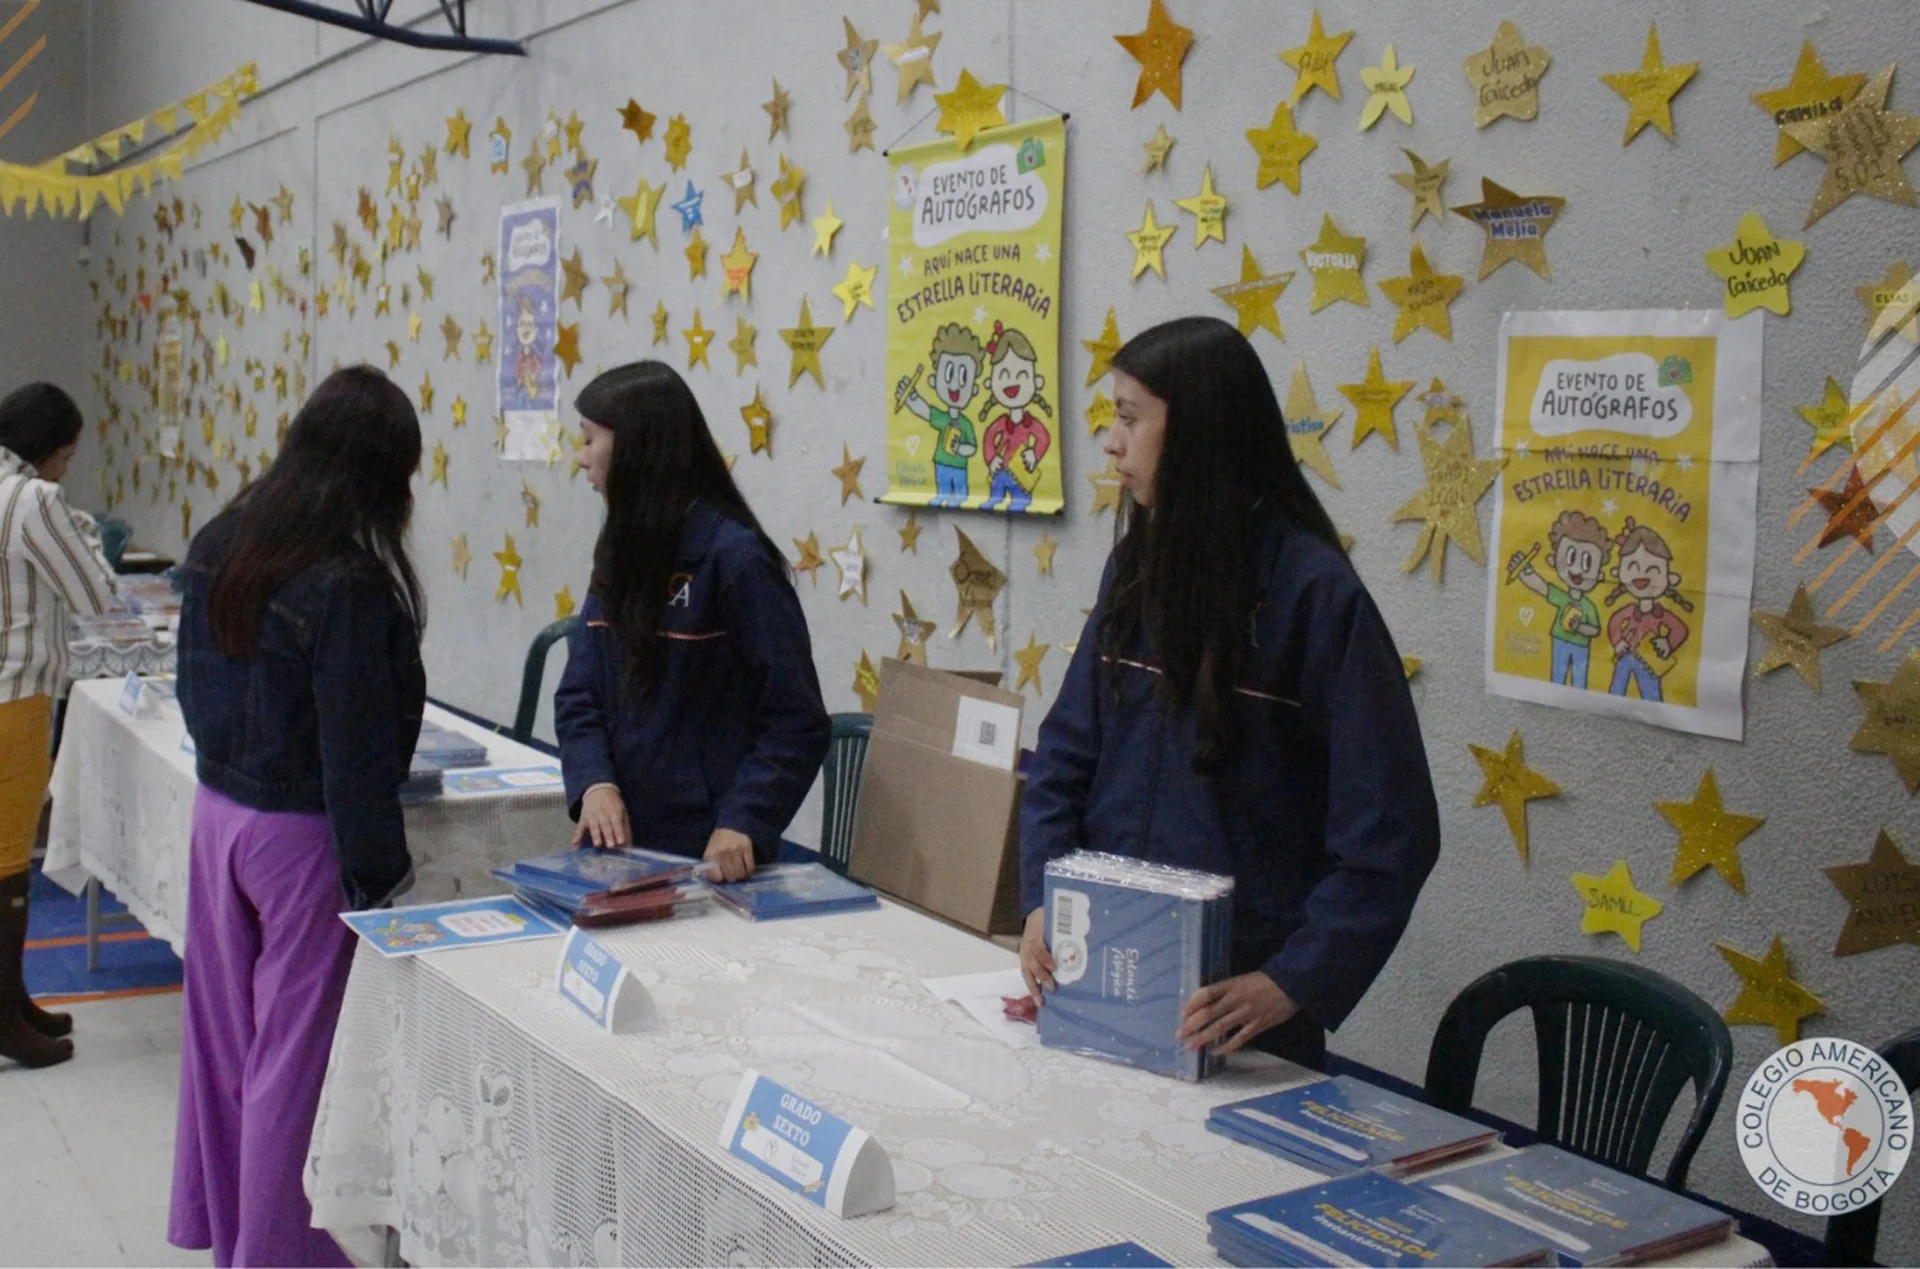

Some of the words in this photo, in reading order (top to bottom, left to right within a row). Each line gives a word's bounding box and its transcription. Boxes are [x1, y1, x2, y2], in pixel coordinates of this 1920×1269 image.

[1482, 47, 1530, 77] Juan
[933, 169, 985, 196] EVENTO
[990, 164, 1007, 185] DE
[921, 185, 1035, 225] AUTÓGRAFOS
[924, 250, 952, 276] AQUÍ
[954, 246, 989, 265] NACE
[993, 244, 1021, 262] UNA
[1306, 251, 1358, 269] VICTORIA
[1729, 240, 1780, 265] JUAN
[897, 277, 965, 324] ESTRELLA
[969, 272, 1052, 320] LITERARIA
[1557, 371, 1618, 392] EVENTO
[1625, 373, 1646, 392] DE
[1541, 389, 1678, 422] AUTÓGRAFOS
[1513, 469, 1592, 502] ESTRELLA
[1598, 467, 1692, 522] LITERARIA
[780, 1093, 822, 1126] GRADO
[772, 1114, 811, 1147] SEXTO
